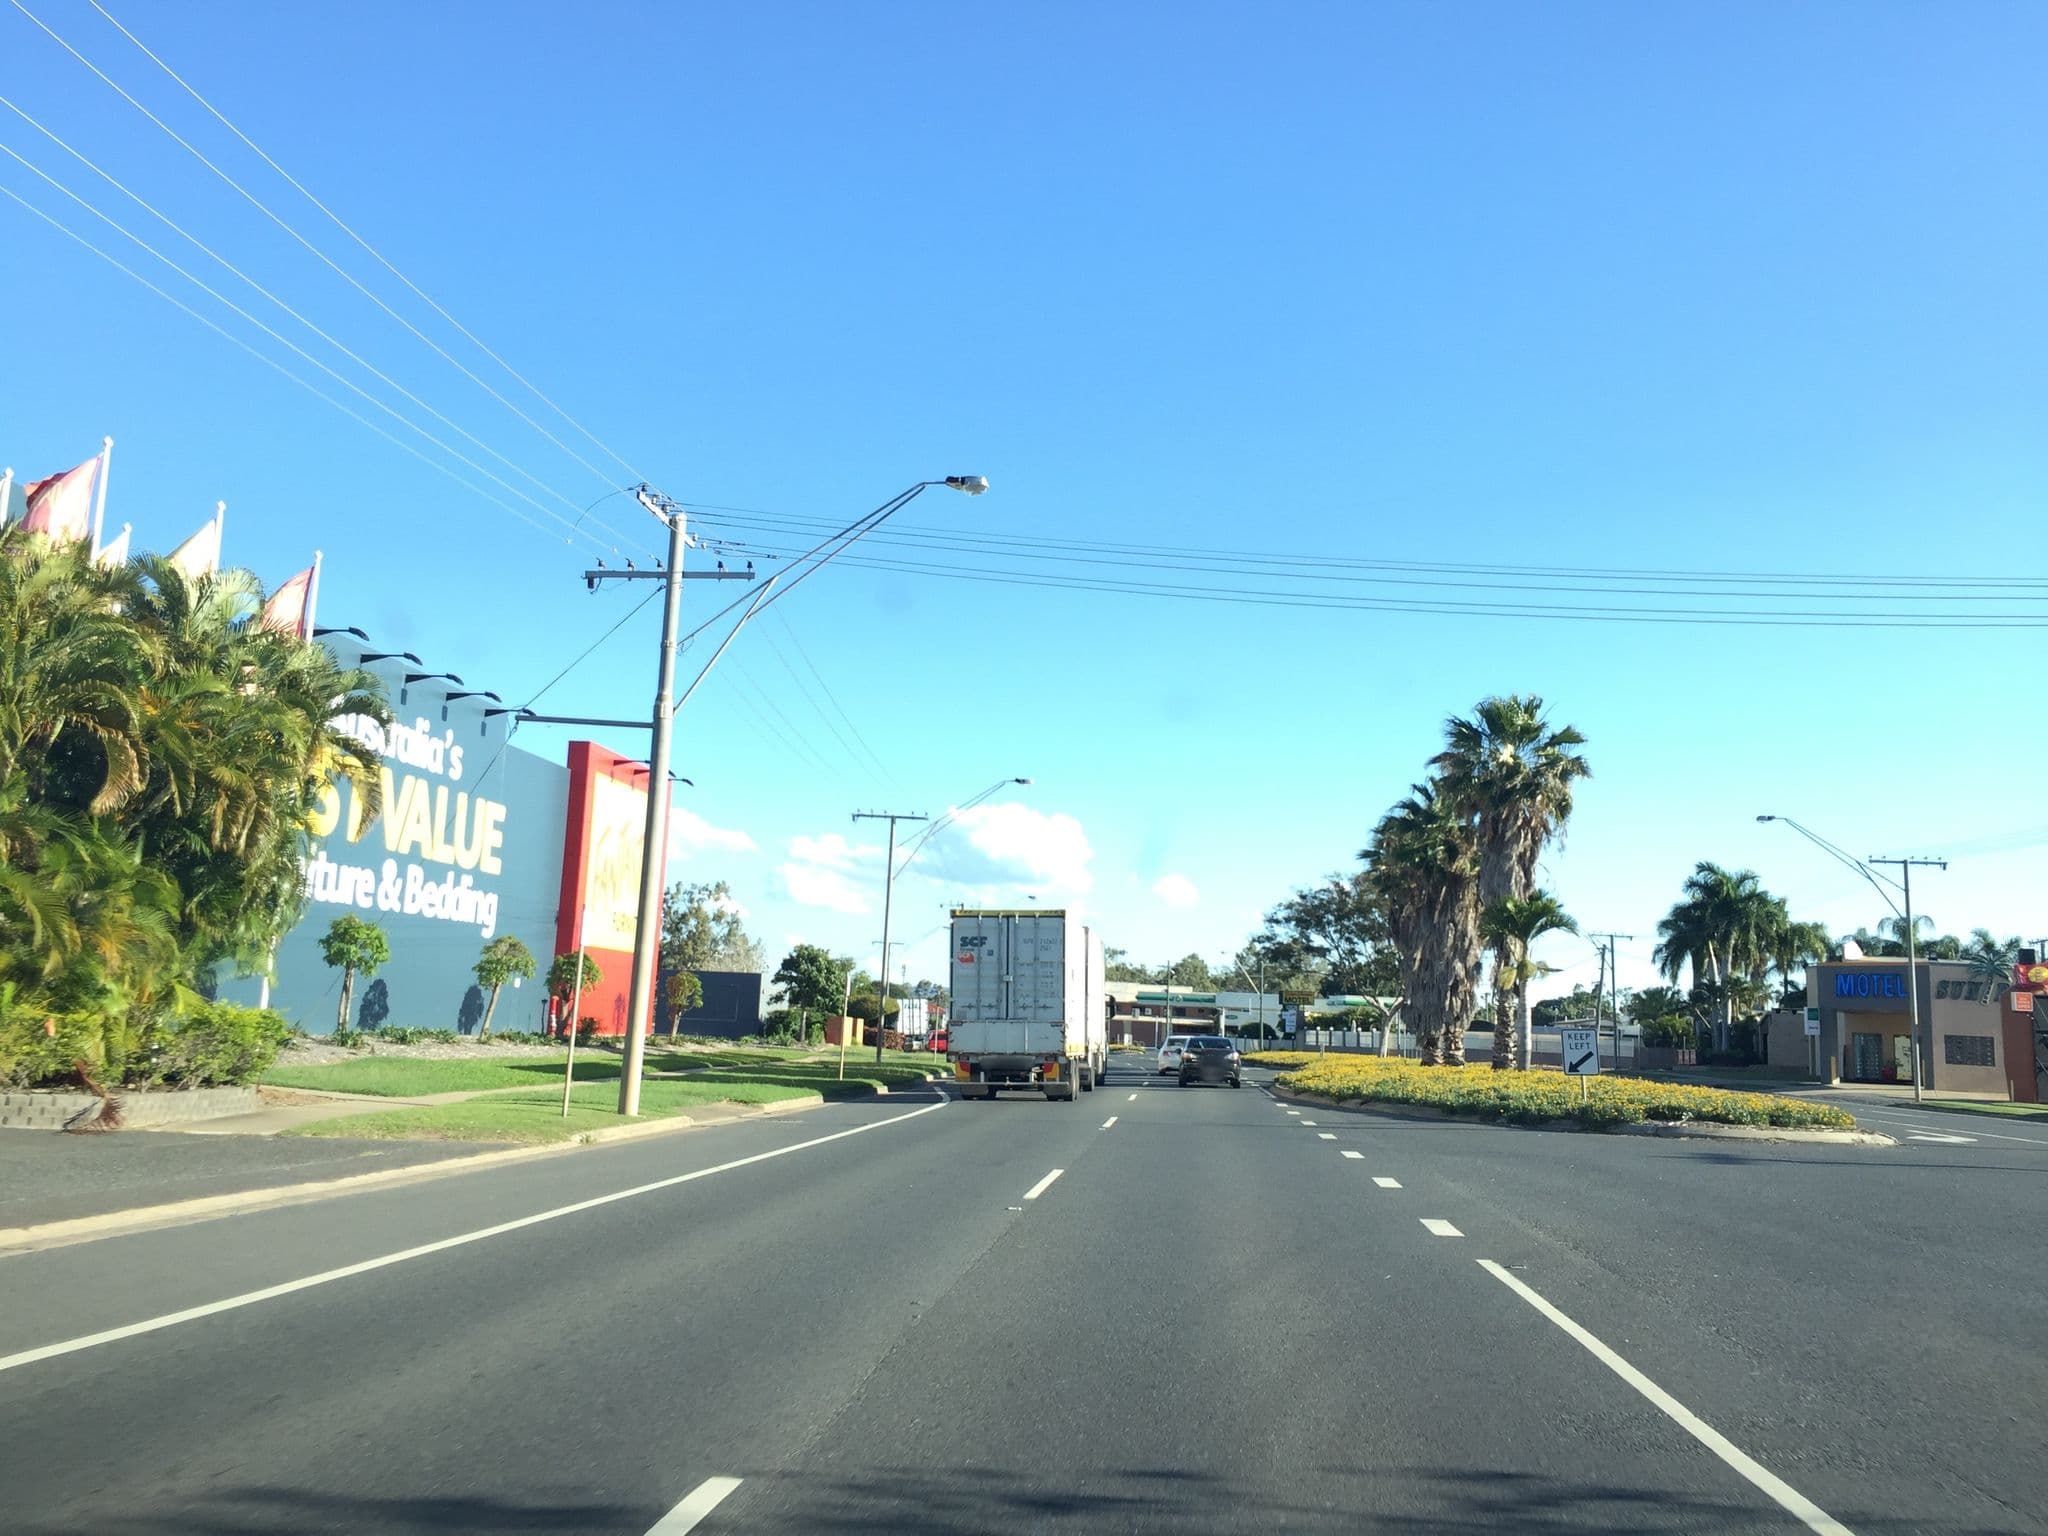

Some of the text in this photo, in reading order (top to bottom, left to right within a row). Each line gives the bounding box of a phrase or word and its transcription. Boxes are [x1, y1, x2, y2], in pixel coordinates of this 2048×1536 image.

[380, 766, 507, 876] VALUE
[377, 858, 403, 913] &
[403, 863, 499, 939] Bedding
[960, 936, 988, 947] SCF
[1835, 973, 1909, 998] MOTEL
[1567, 1033, 1592, 1041] KEEP
